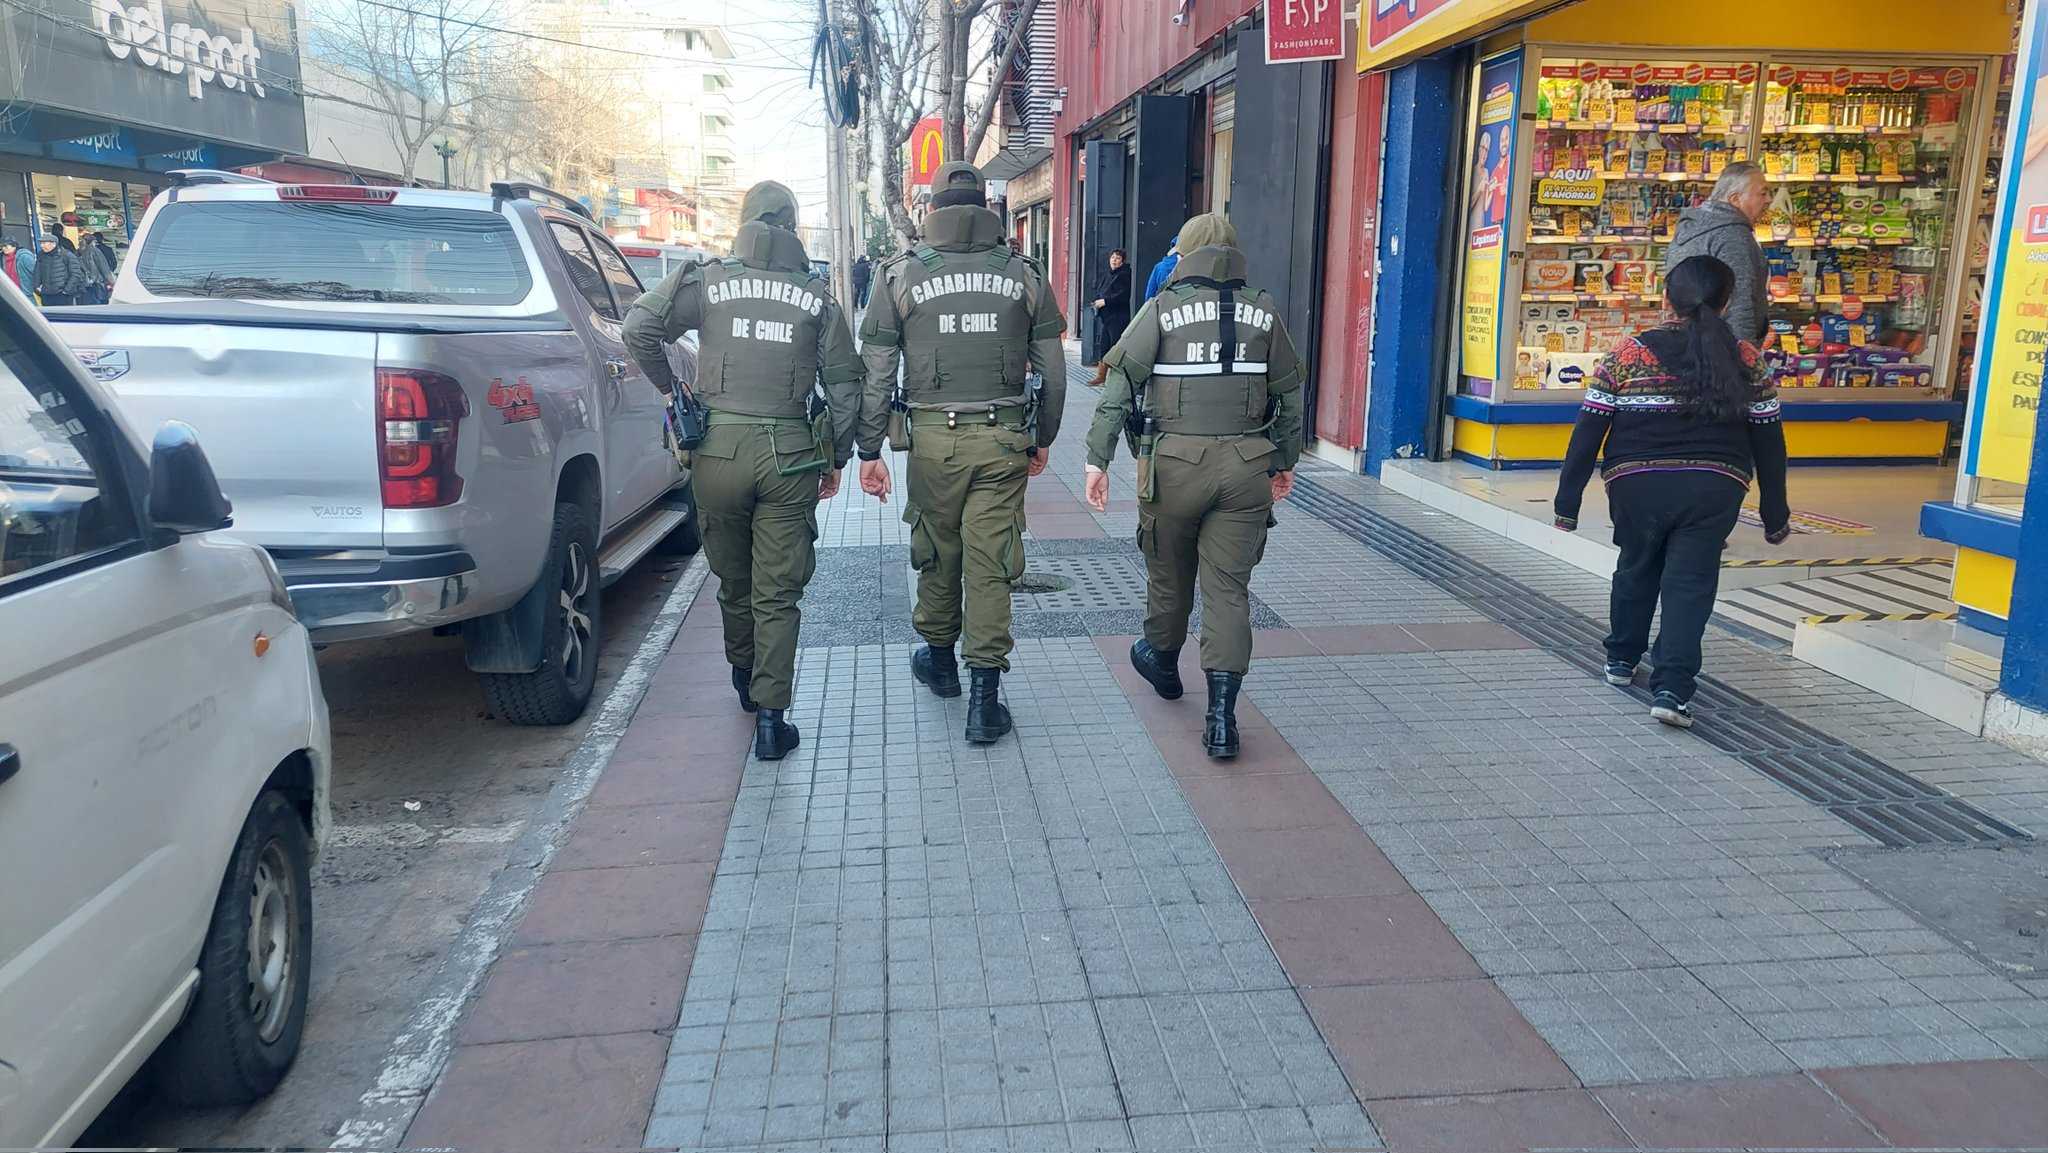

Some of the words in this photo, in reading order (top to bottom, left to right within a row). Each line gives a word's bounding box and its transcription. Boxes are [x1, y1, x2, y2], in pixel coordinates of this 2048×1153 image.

[1285, 0, 1329, 28] FSP
[707, 278, 823, 317] CARABINEROS
[912, 272, 1024, 305] CARABINEROS
[732, 317, 750, 338] DE
[755, 320, 794, 344] CHILE
[939, 314, 956, 334] DE
[961, 313, 998, 333] CHILE
[1187, 342, 1204, 362] DE
